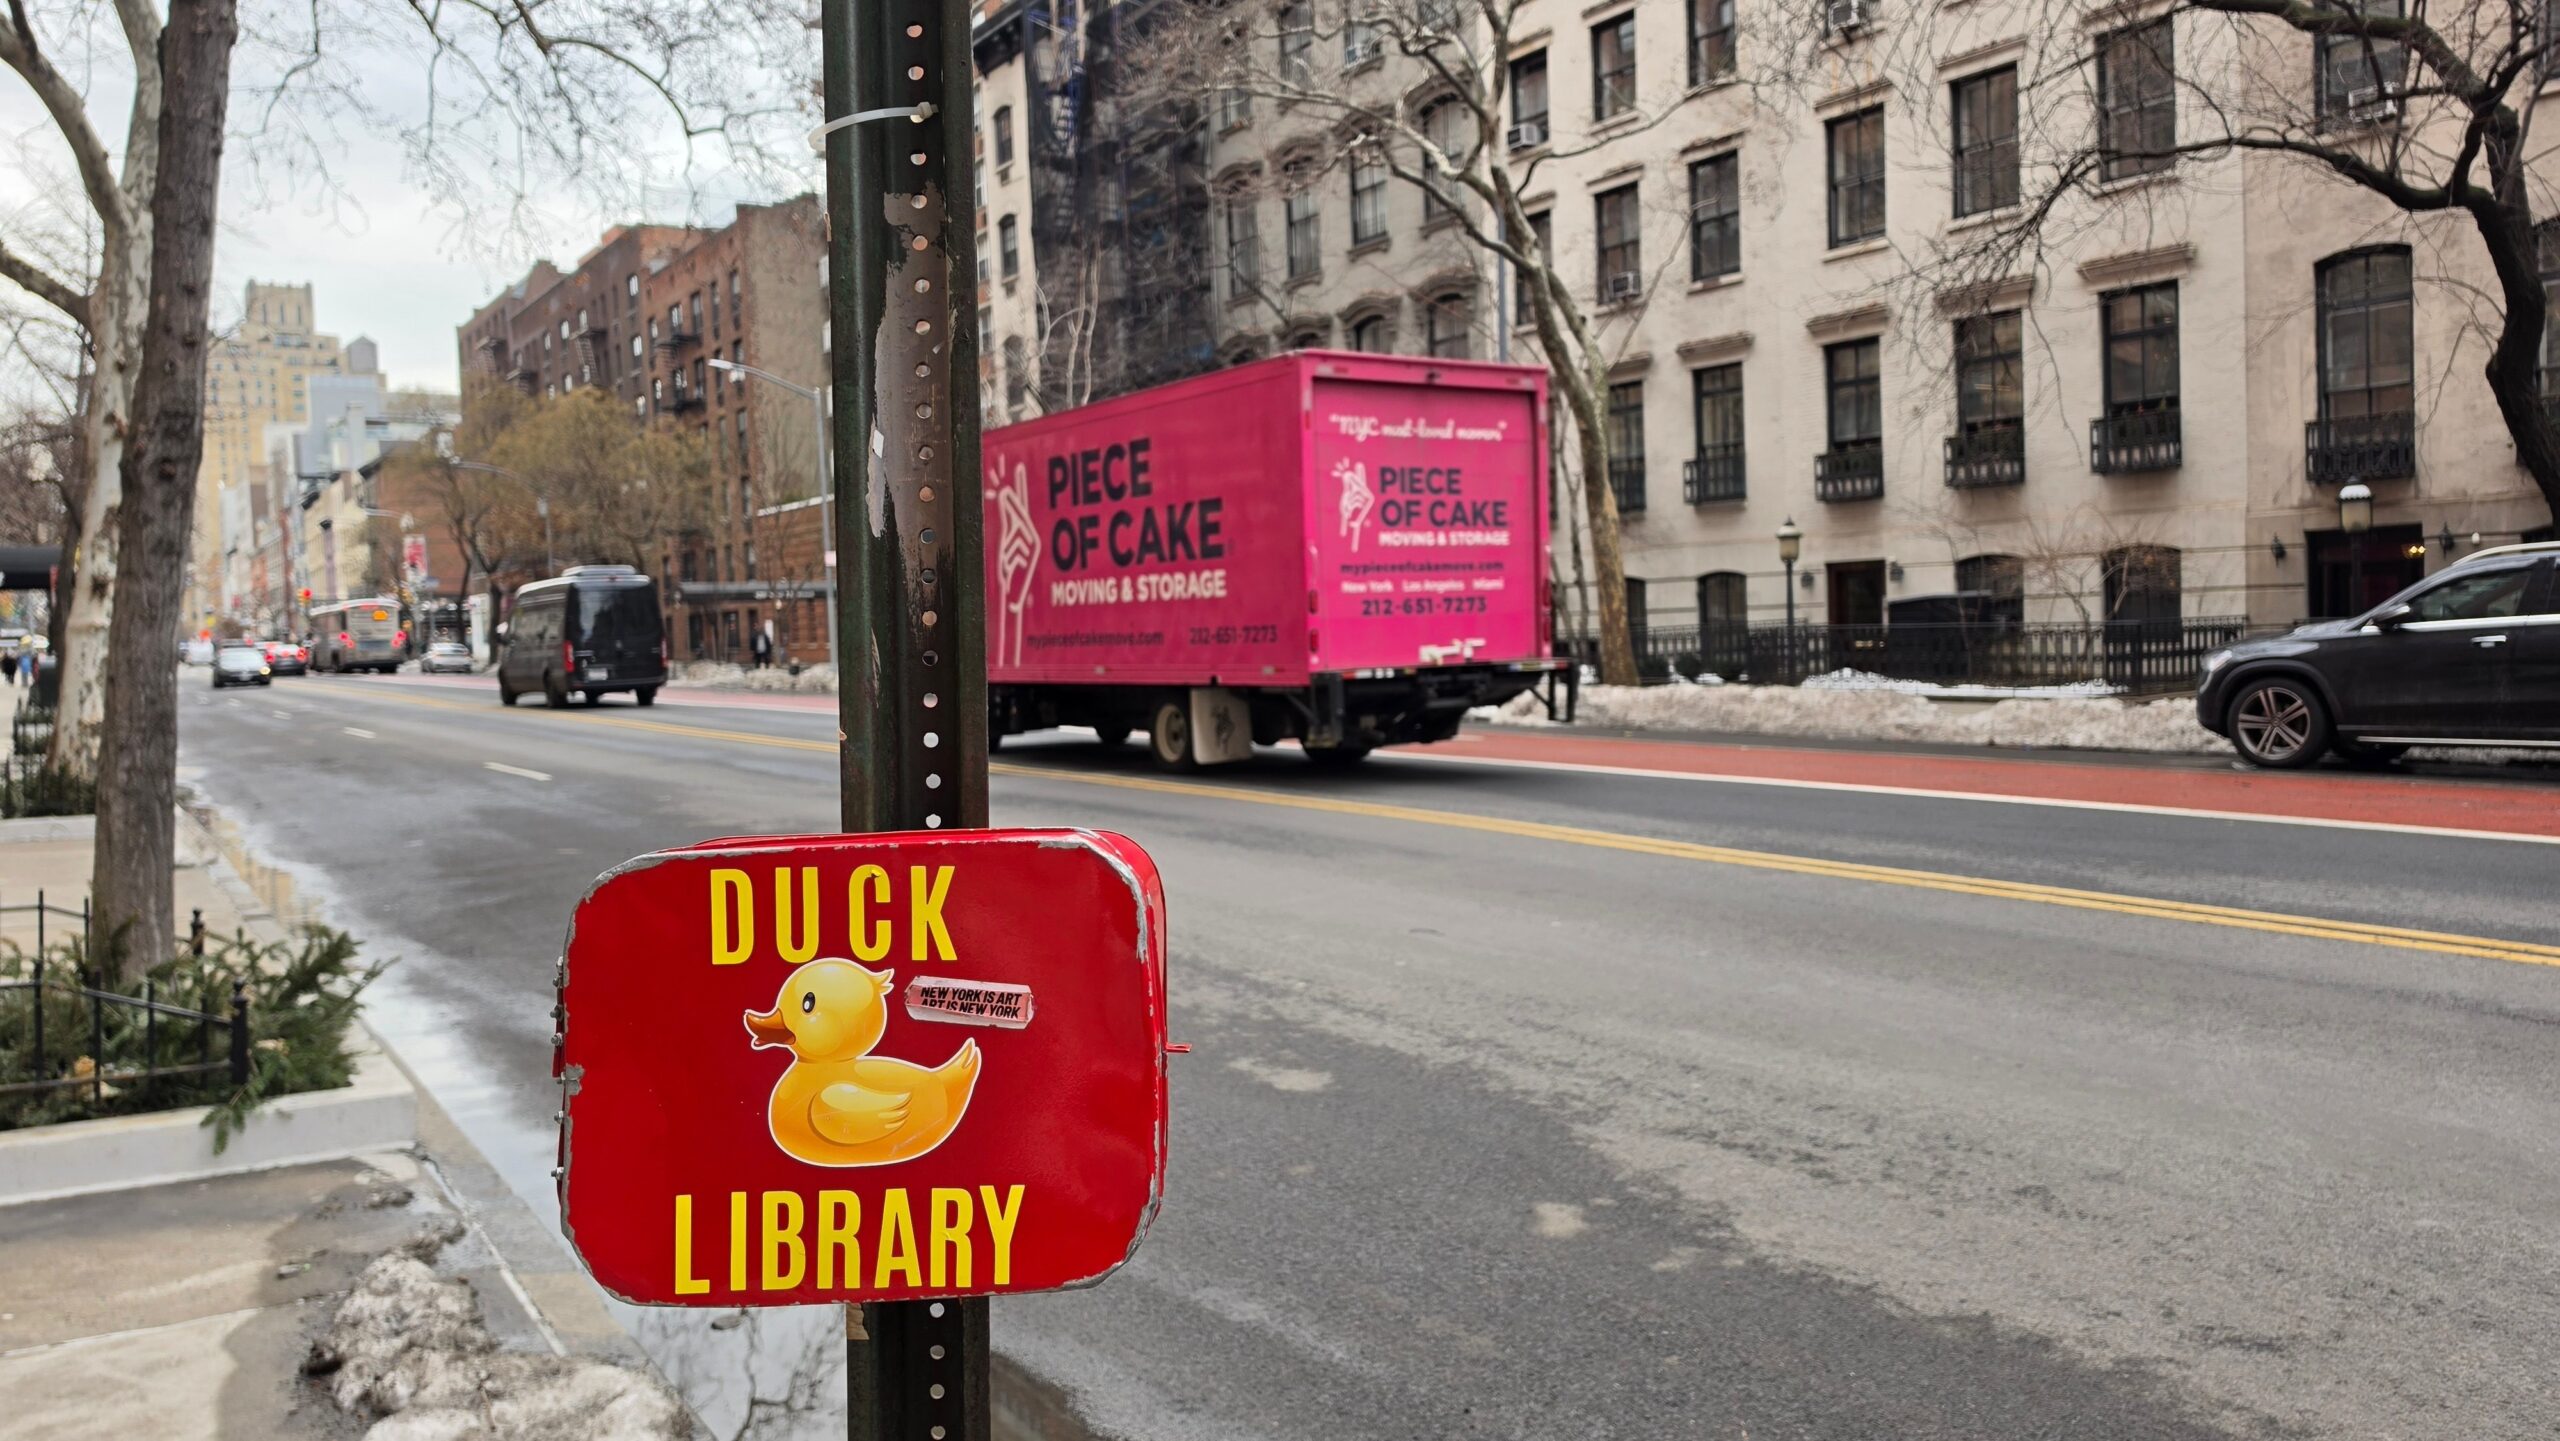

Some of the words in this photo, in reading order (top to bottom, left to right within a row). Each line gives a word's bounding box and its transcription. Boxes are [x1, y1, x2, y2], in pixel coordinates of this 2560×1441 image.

[1049, 437, 1152, 509] PIECE
[1380, 467, 1462, 495] PIECE
[1381, 499, 1421, 527] OF
[1429, 500, 1507, 528] CAKE
[1053, 516, 1099, 572] OF
[1109, 497, 1224, 567] CAKE
[1379, 532, 1434, 546] MOVING
[1436, 531, 1447, 546] &
[1449, 531, 1510, 546] STORAGE
[1051, 577, 1117, 606] MOVING
[1121, 576, 1133, 602] &
[1137, 569, 1227, 602] STORAGE
[1362, 596, 1487, 616] 212-651-7273
[1189, 625, 1278, 646] 212-651-7273
[710, 864, 957, 965] DUCK
[920, 987, 949, 999] NEW
[951, 988, 982, 1002] YORK
[983, 991, 995, 1003] IS
[995, 992, 1022, 1006] ART
[958, 1002, 988, 1015] NEW
[988, 1004, 1020, 1019] YORK
[675, 1185, 1026, 1294] LIBRARY
